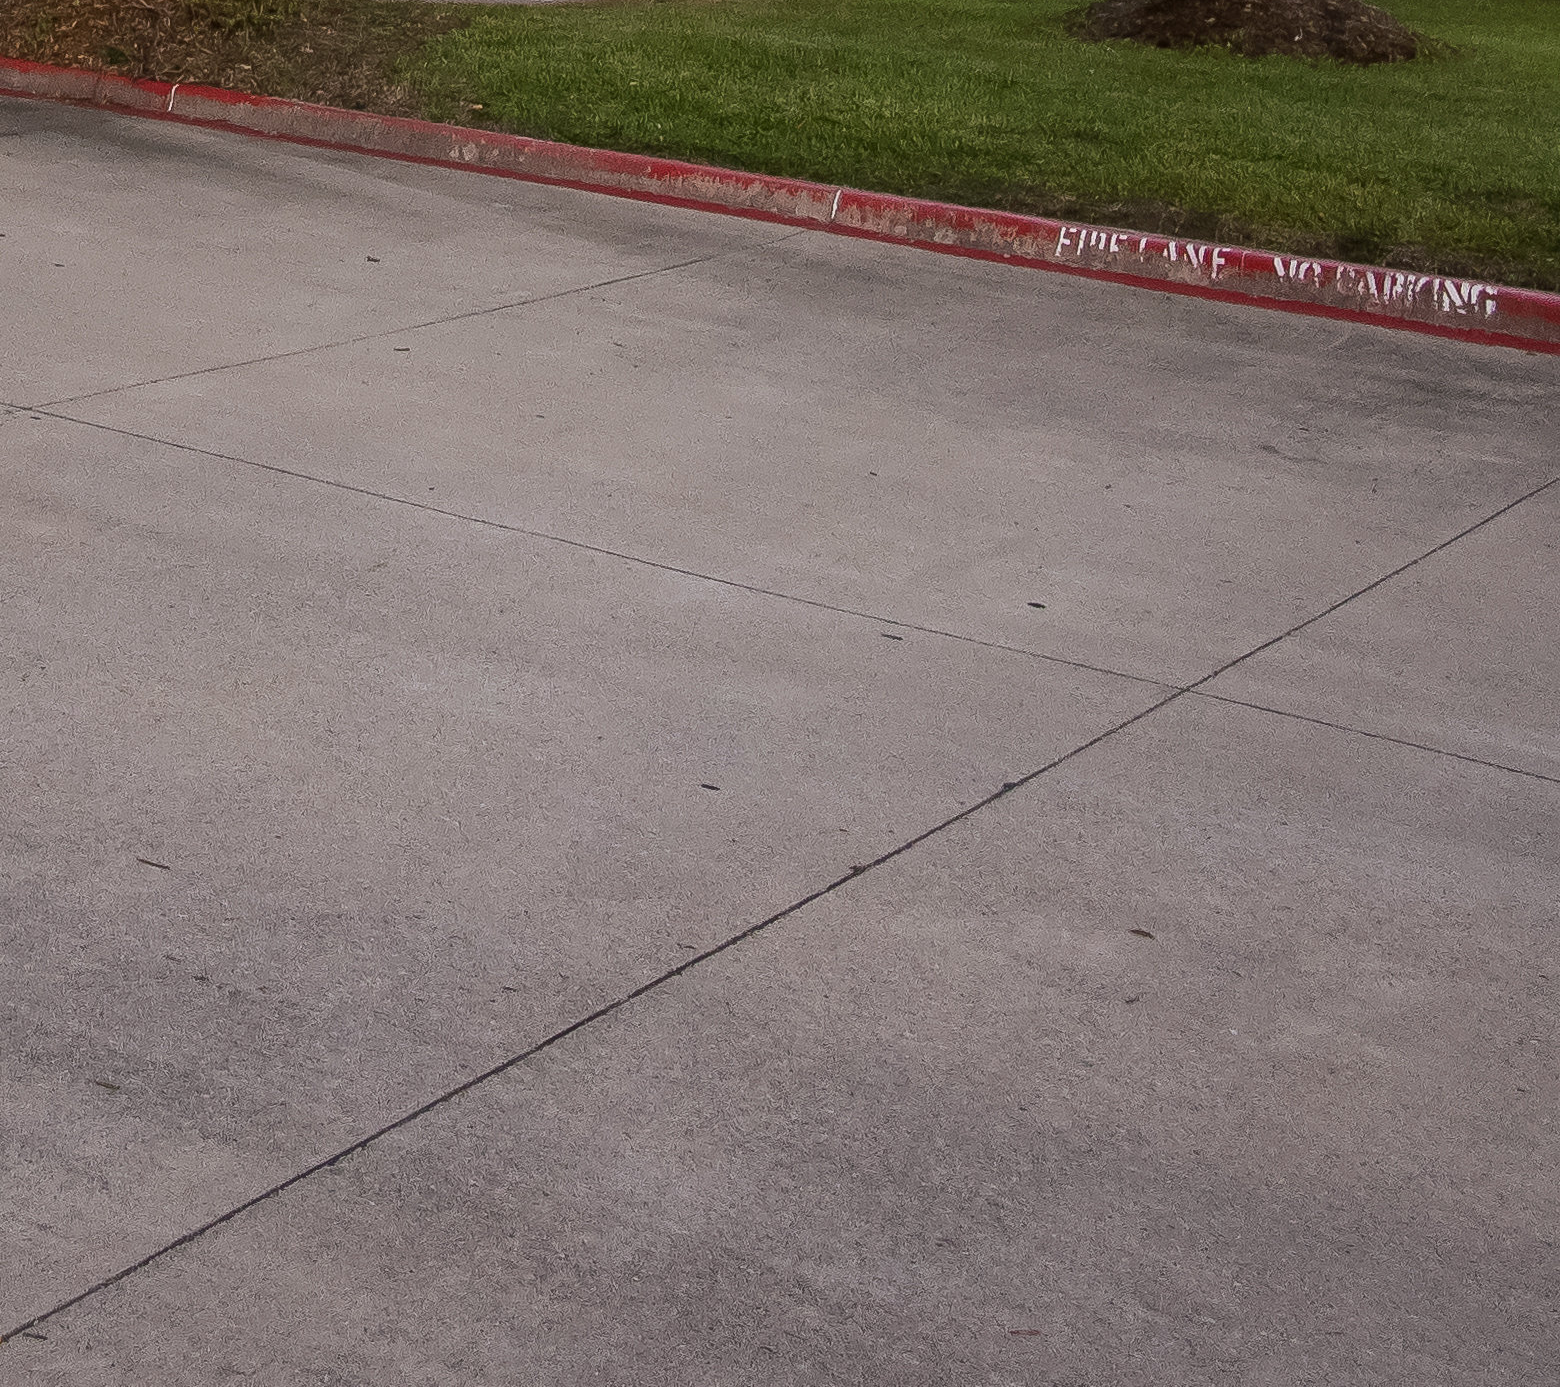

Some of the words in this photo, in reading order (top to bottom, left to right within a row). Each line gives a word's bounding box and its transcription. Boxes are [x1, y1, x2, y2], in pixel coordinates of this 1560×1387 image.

[1054, 226, 1129, 258] FIRE
[1273, 256, 1323, 289] NO
[1336, 264, 1499, 320] PARKING
